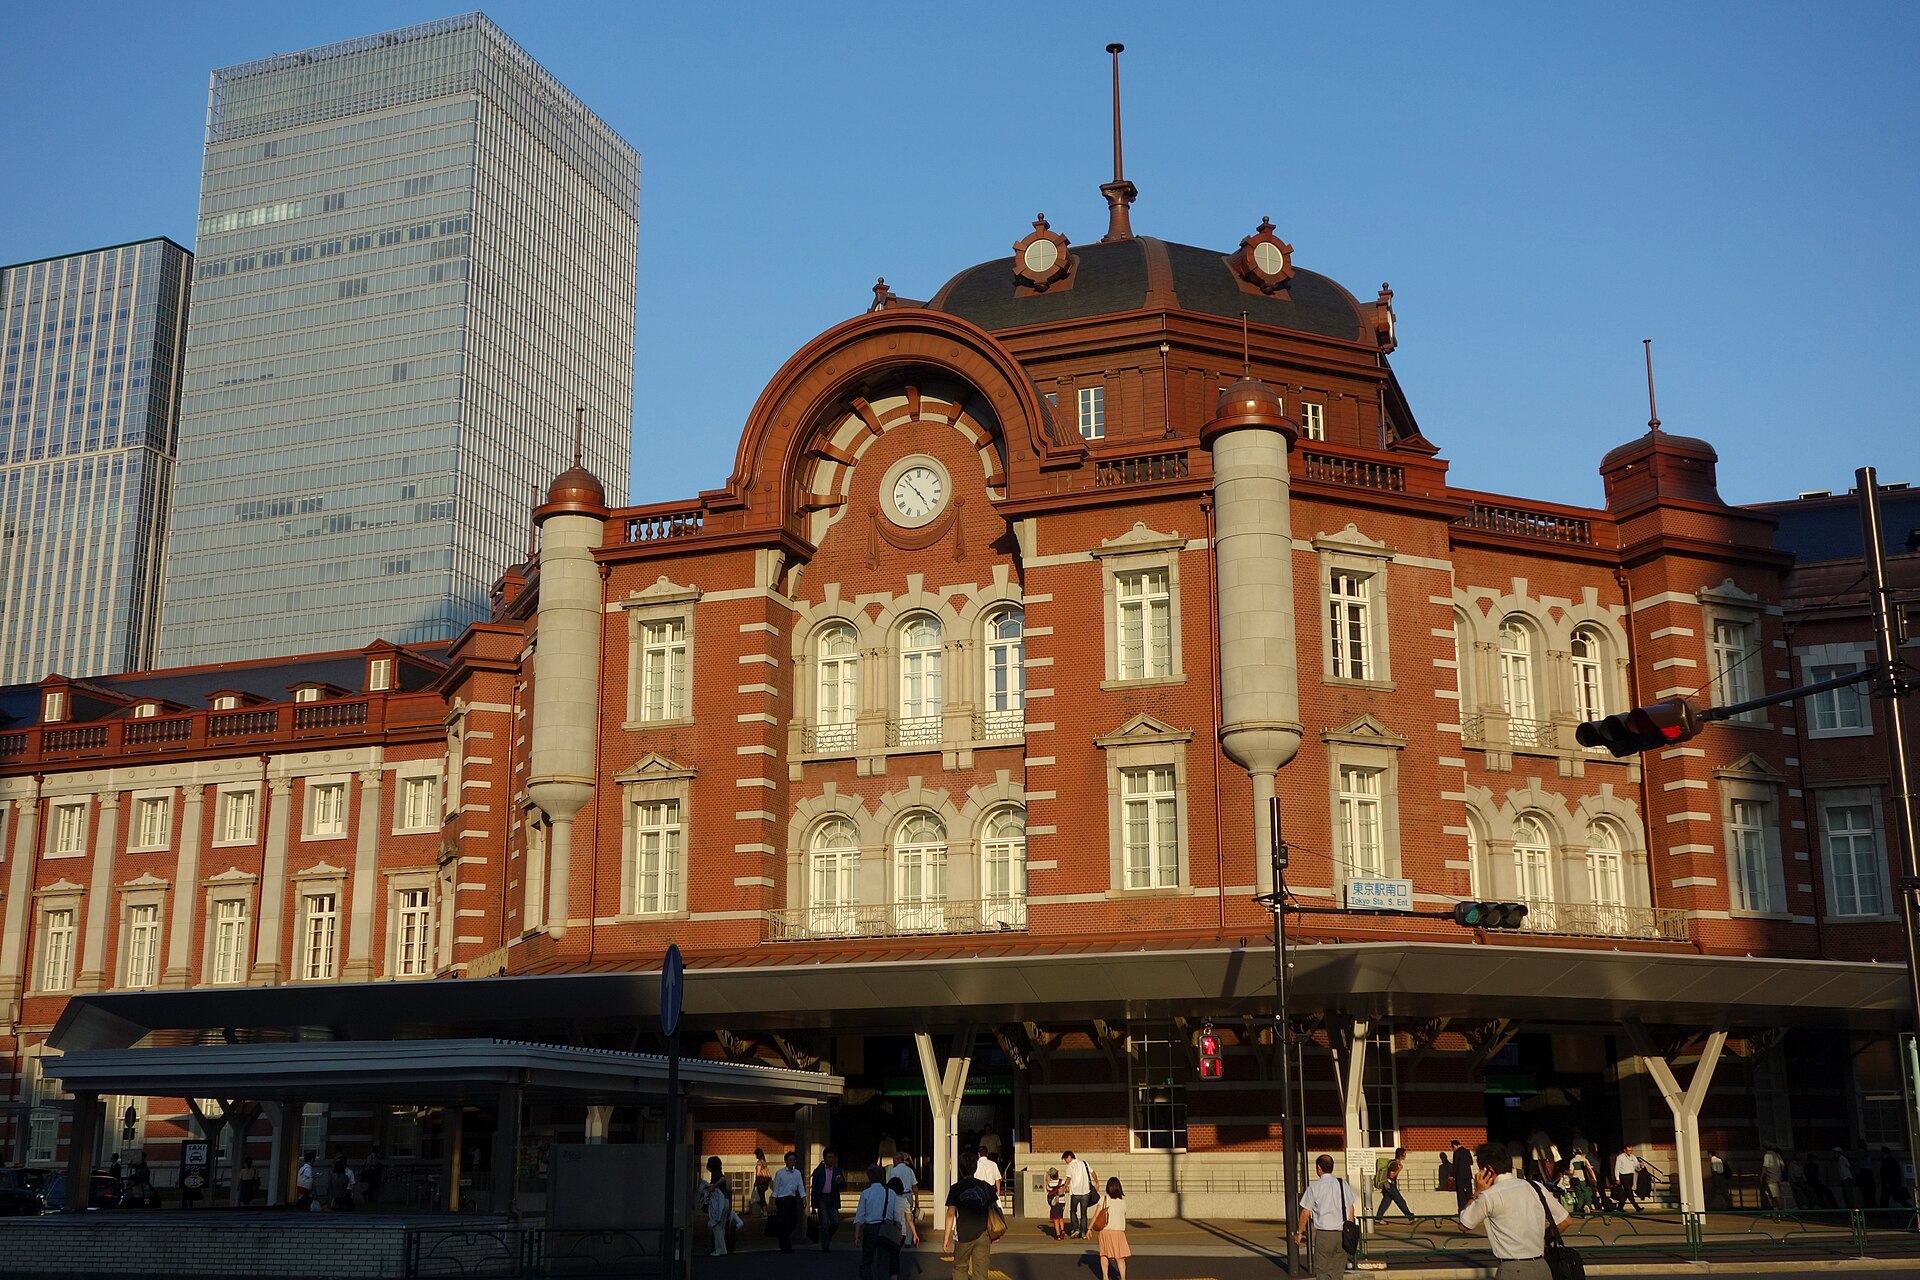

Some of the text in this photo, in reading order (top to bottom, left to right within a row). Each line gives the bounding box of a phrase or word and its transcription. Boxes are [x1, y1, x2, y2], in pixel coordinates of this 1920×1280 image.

[1353, 882, 1407, 896] 東京駅南口
[1351, 896, 1370, 905] Tokyo
